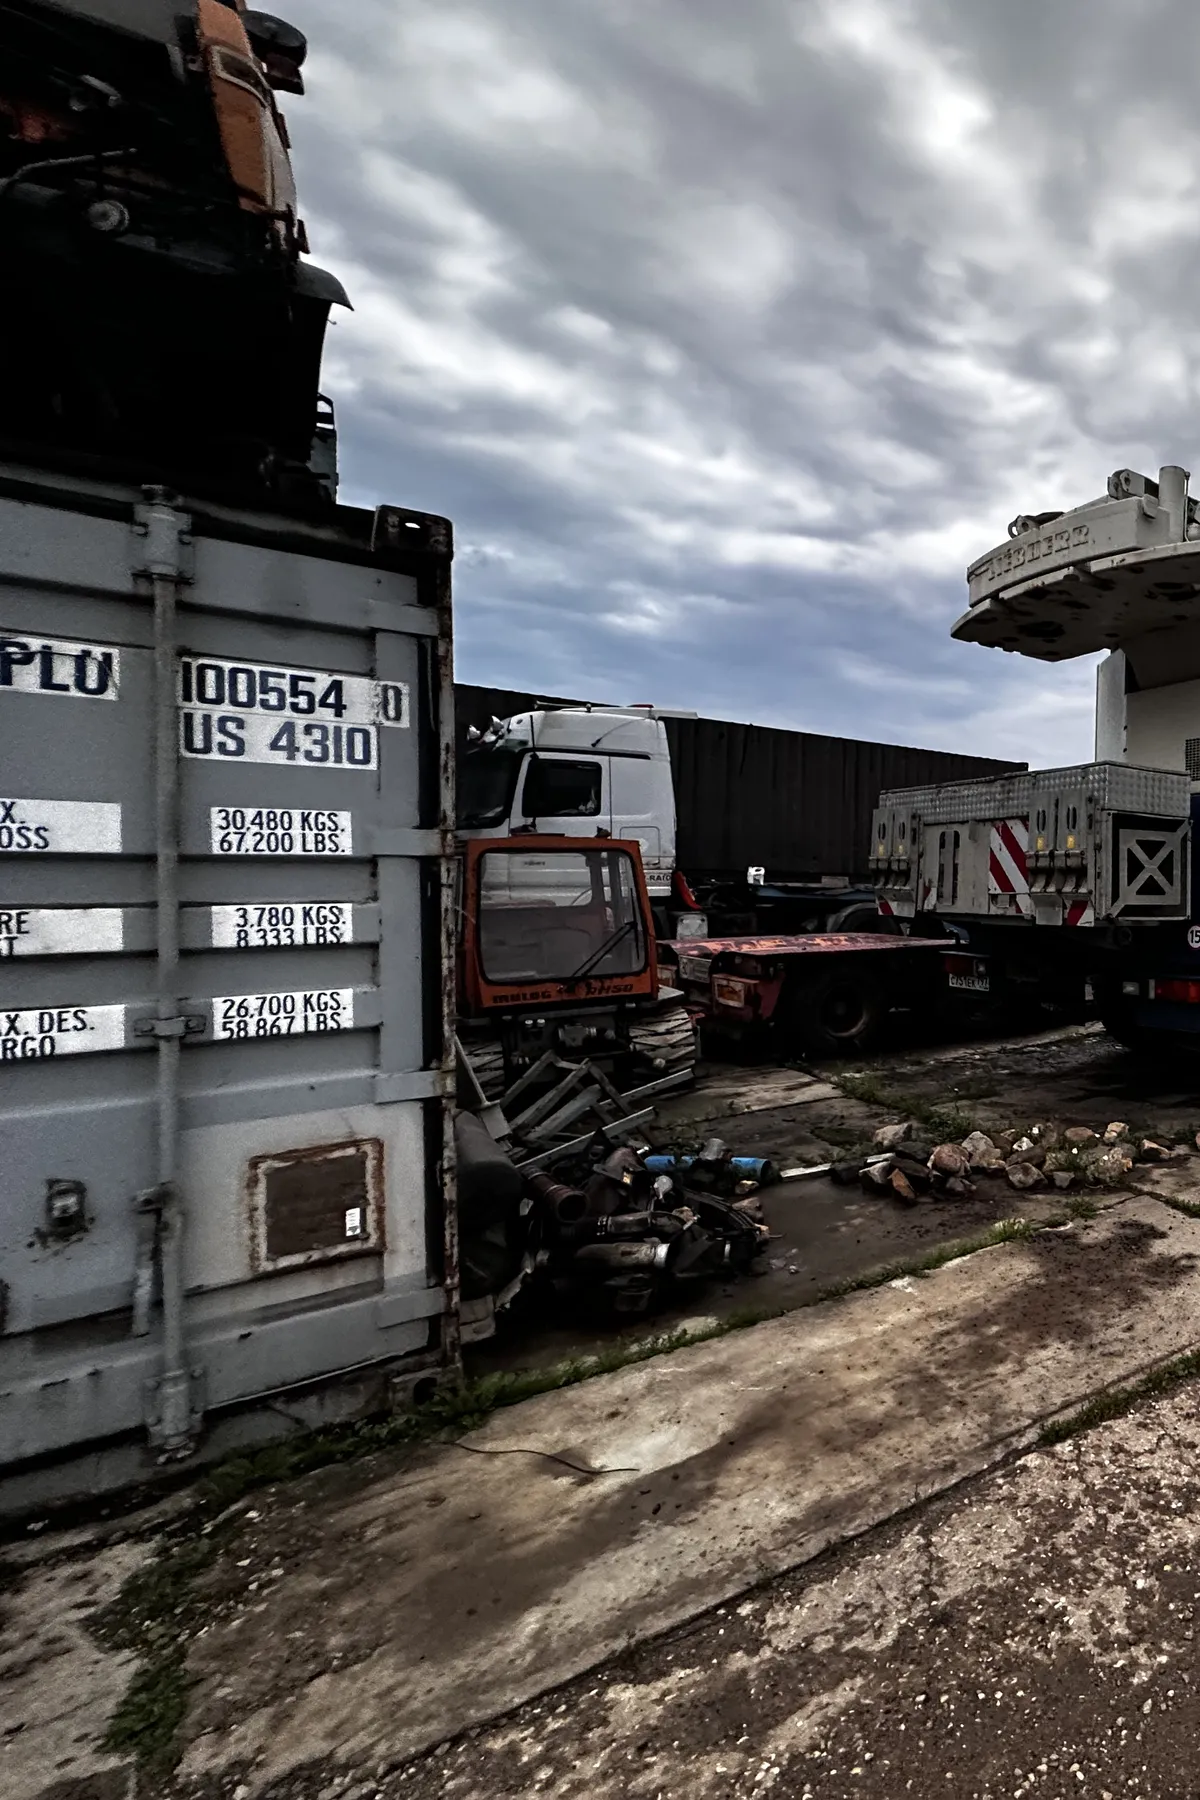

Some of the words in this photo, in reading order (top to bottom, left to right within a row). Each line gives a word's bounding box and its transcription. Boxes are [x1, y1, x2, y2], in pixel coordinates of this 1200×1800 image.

[182, 661, 347, 718] 100554
[184, 712, 245, 757] US
[270, 722, 371, 766] 4310
[217, 809, 292, 831] 30,480
[301, 811, 345, 832] KGS.
[219, 832, 293, 853] 67,200
[301, 833, 345, 853] LBS.
[235, 907, 294, 928] 3,780
[302, 906, 346, 926] KGS.
[236, 928, 295, 948] 8333
[1190, 929, 1200, 944] 15
[222, 995, 295, 1019] 26,700
[304, 992, 347, 1012] KGS.
[0, 1013, 29, 1037] X.
[38, 1010, 95, 1034] DES.
[222, 1015, 295, 1039] 58867
